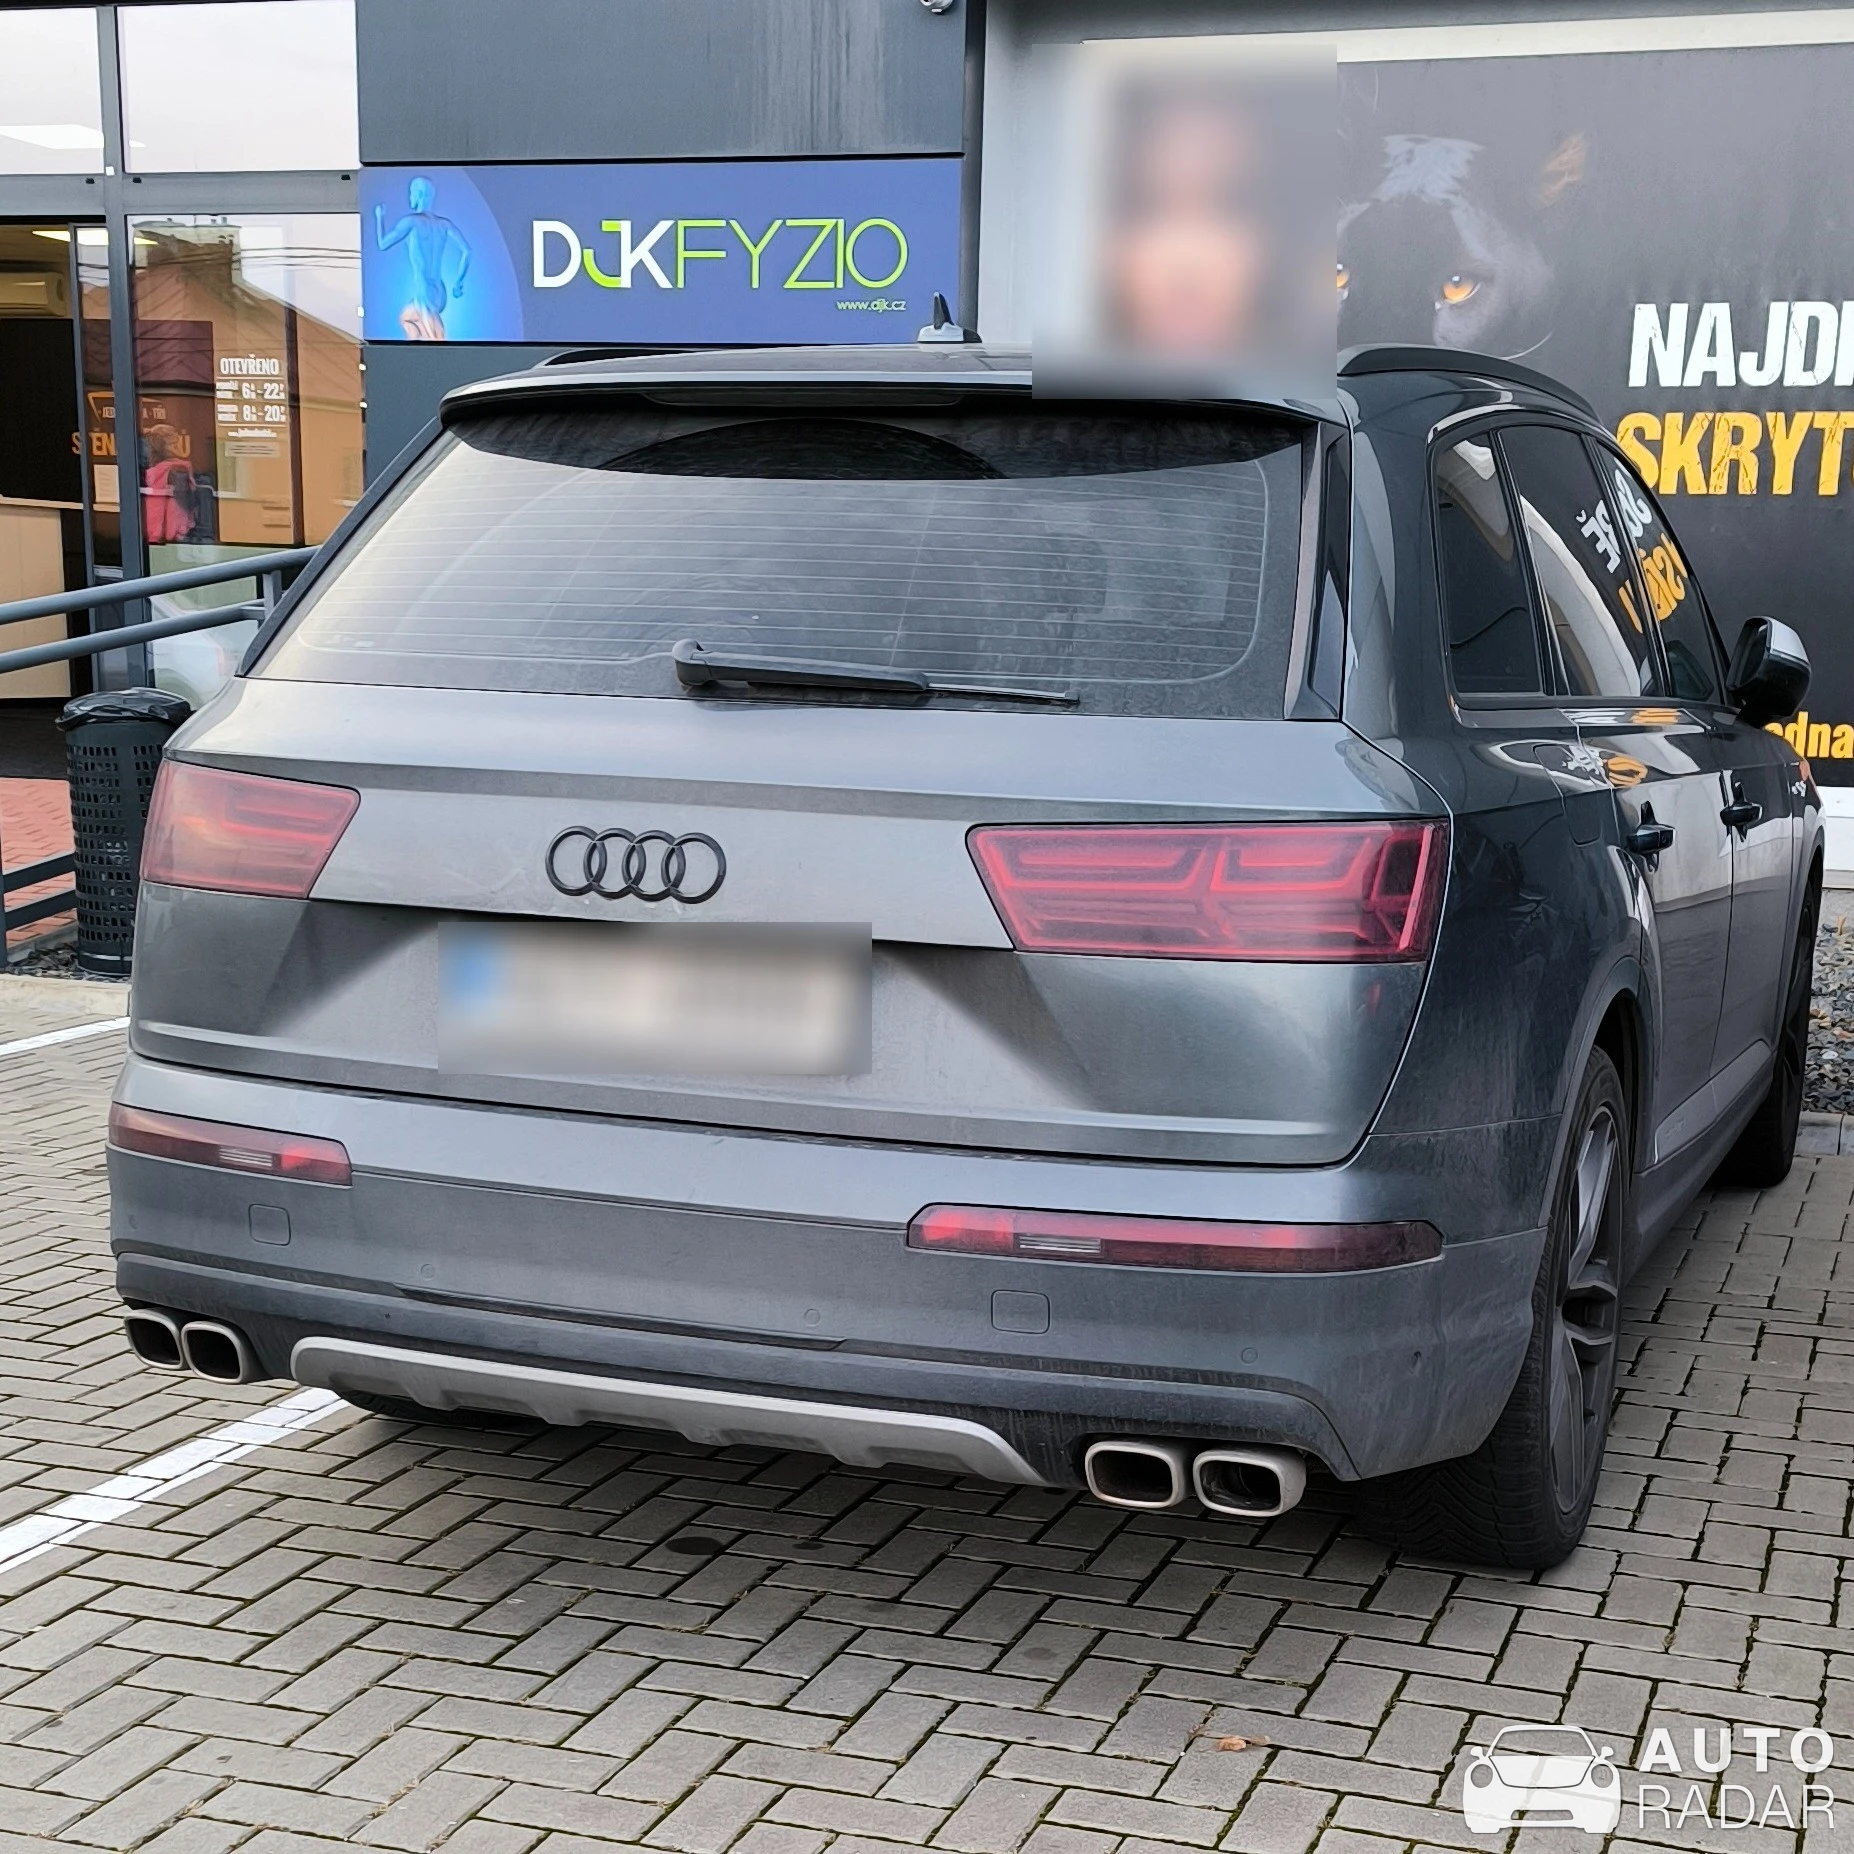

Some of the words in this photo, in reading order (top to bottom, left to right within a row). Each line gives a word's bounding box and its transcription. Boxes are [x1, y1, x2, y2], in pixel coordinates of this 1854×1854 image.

[533, 217, 909, 289] DJKFYZIO
[220, 353, 280, 375] OTEVŘENO
[1617, 411, 1854, 496] SKRYT
